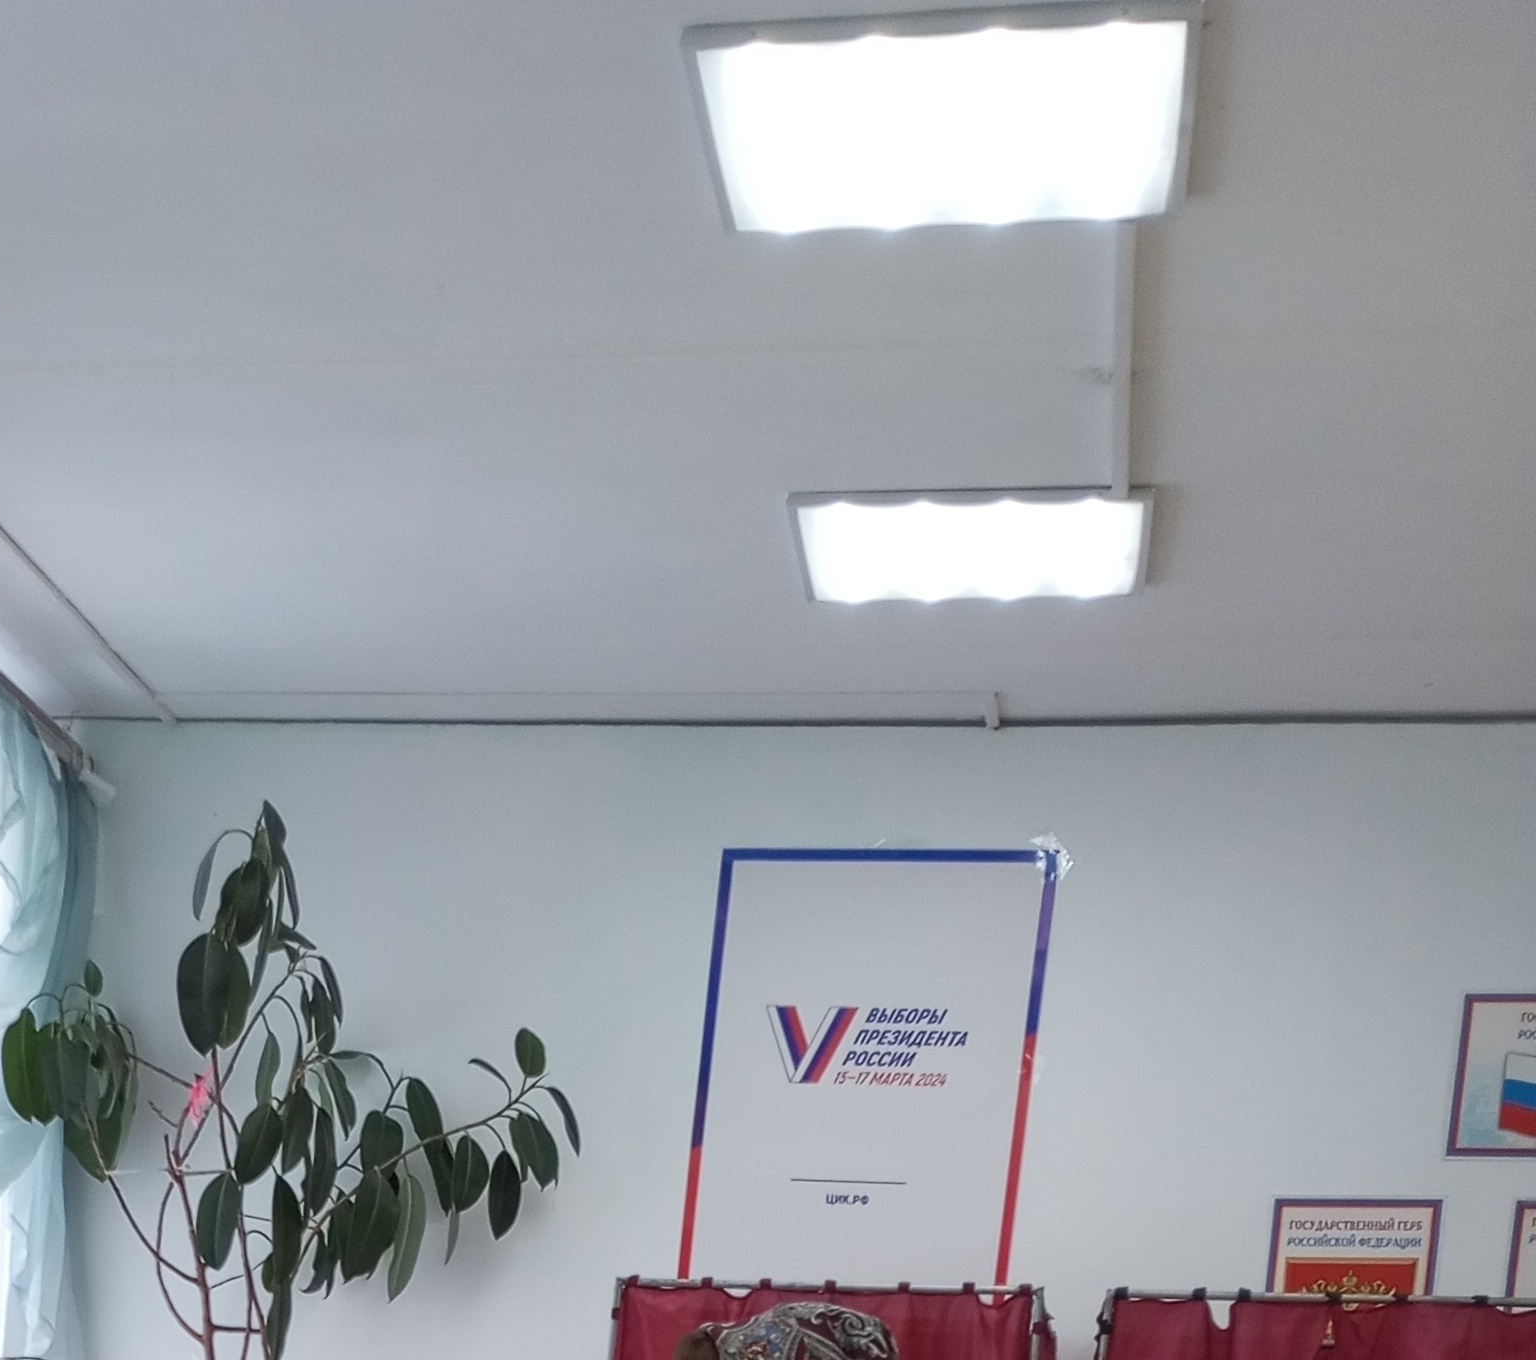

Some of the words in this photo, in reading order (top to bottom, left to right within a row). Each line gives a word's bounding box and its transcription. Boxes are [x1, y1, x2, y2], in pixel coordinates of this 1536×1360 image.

[864, 1007, 948, 1025] ВЫБОРЫ
[853, 1029, 968, 1049] ПРЕЗИДЕНТА
[842, 1051, 917, 1068] РОССИИ
[869, 1072, 914, 1087] МАРТА
[915, 1073, 947, 1087] 2024
[825, 1194, 869, 1205] ЦИК.РФ
[1289, 1217, 1395, 1231] ГОСУДАРСТВЕННЫЙ
[1397, 1220, 1423, 1231] ГЕРБ
[1286, 1234, 1356, 1248] РОССИЙСКОЙ
[1358, 1237, 1422, 1249] ФЕДЕРАЦИИ
